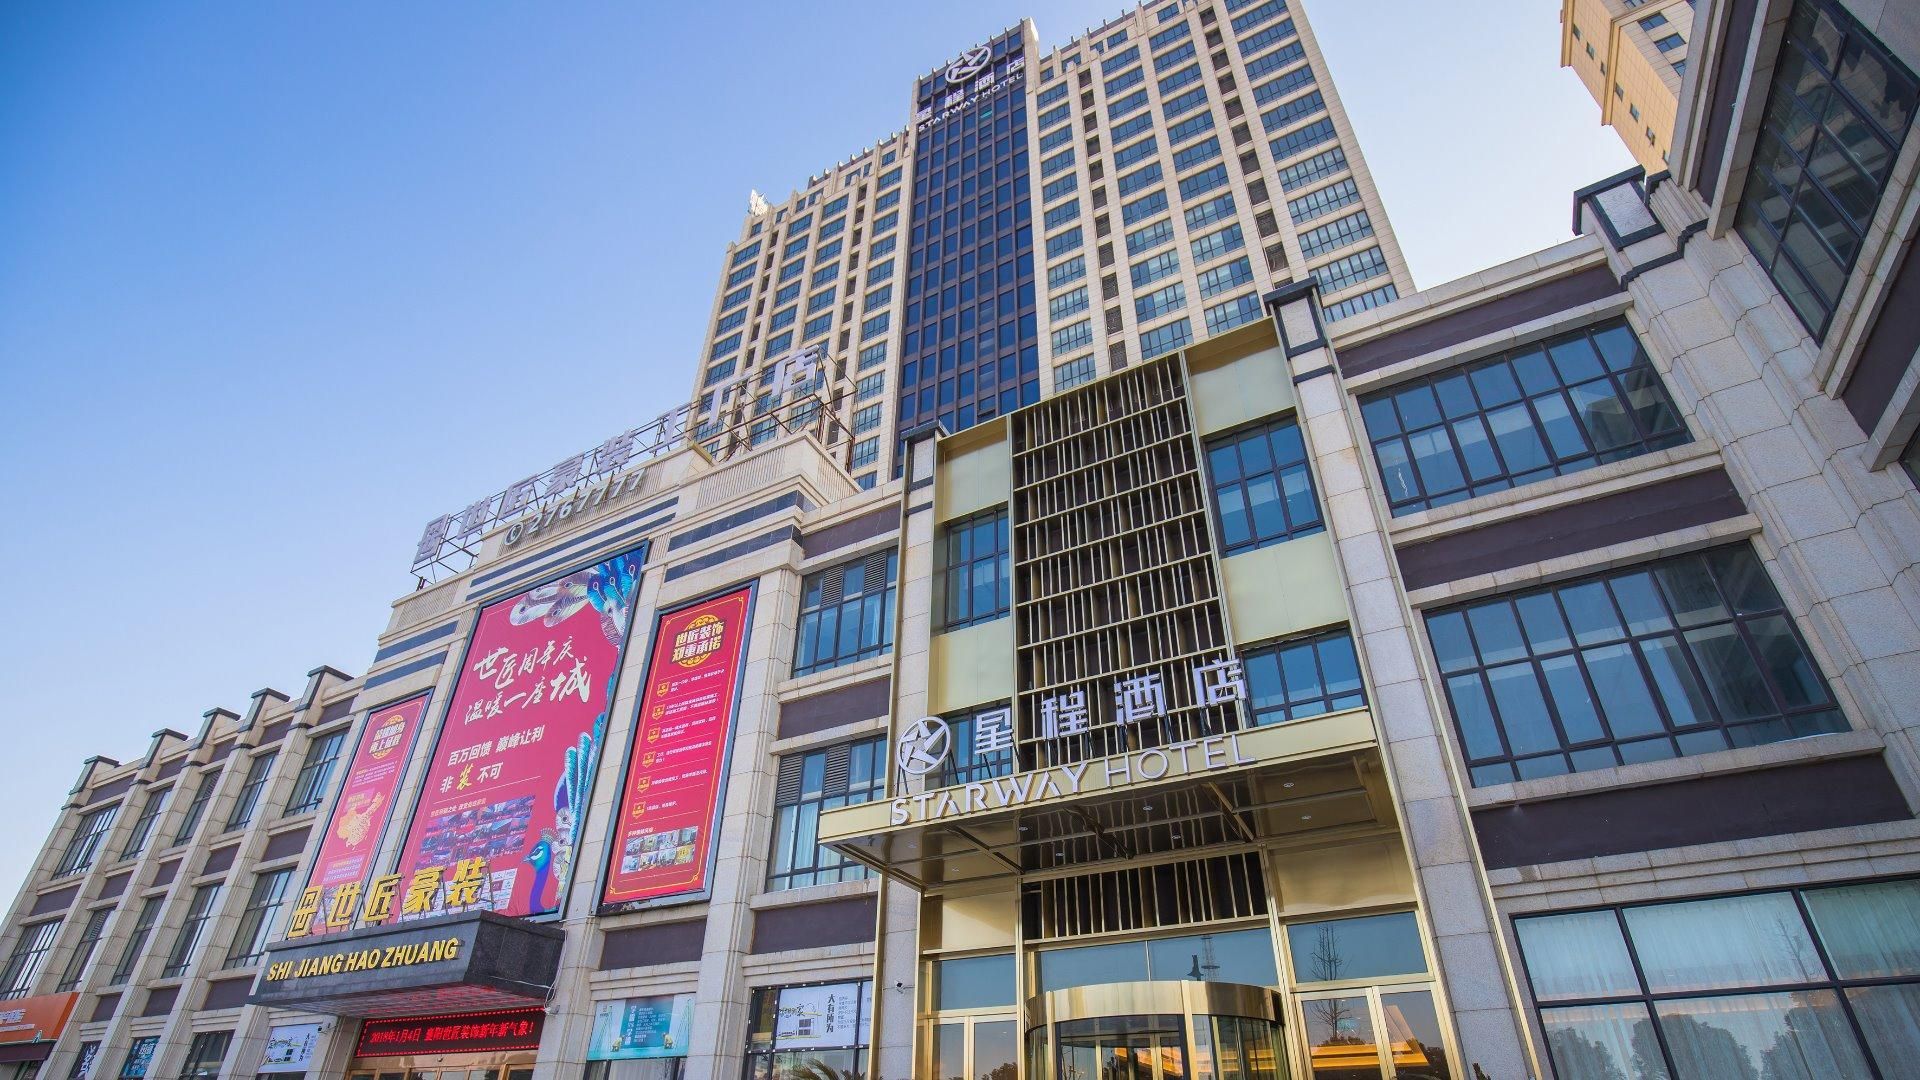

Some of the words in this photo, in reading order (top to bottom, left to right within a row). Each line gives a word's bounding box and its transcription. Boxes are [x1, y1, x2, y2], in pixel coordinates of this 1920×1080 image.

[918, 96, 980, 132] STARWAY
[982, 72, 1024, 99] HOTEL
[527, 467, 647, 534] 2767777
[671, 635, 722, 662] 郑重承诺
[675, 621, 725, 647] 世匠装饰
[473, 636, 574, 690] 世匠周年庆
[464, 656, 592, 725] 温暖一座城
[975, 657, 1247, 755] 星程酒店
[447, 740, 493, 767] 百万回馈
[495, 724, 546, 753] 巅峰让利
[477, 762, 504, 783] 不可
[890, 761, 1090, 827] STARWAY
[1104, 733, 1257, 789] HOTEL
[326, 856, 488, 928] 世匠豪装
[266, 960, 293, 981] SHI
[294, 953, 344, 978] JIANG
[344, 948, 381, 972] HAO
[380, 937, 460, 968] ZHUANG
[825, 993, 836, 1033] 大有所为
